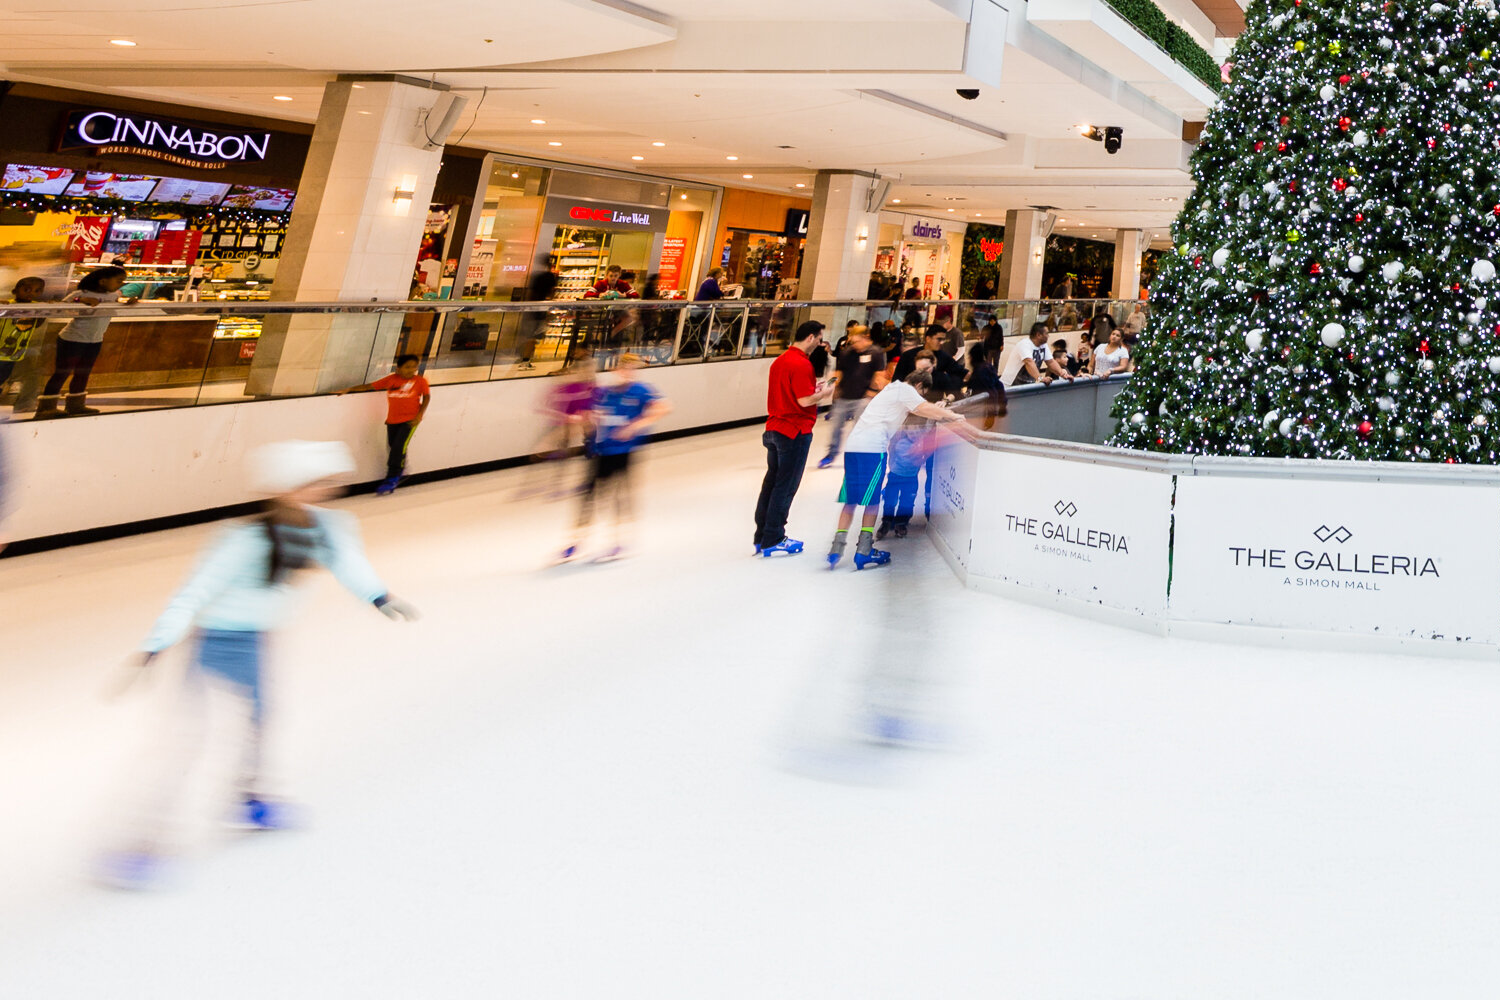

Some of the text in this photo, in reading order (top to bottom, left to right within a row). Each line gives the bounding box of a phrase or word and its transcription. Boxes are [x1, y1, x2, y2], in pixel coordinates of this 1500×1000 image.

[78, 111, 271, 160] CINNABON
[100, 147, 226, 169] WORLD FAMOUS CINNAMON ROLLS
[569, 206, 612, 222] GNC
[912, 220, 942, 239] claire's
[1005, 514, 1129, 554] THE GALLERIA
[1041, 545, 1068, 557] SIMON
[1069, 551, 1092, 563] MALL
[1228, 547, 1440, 578] THE GALLERIA
[1283, 577, 1381, 591] A SIMON MALL
